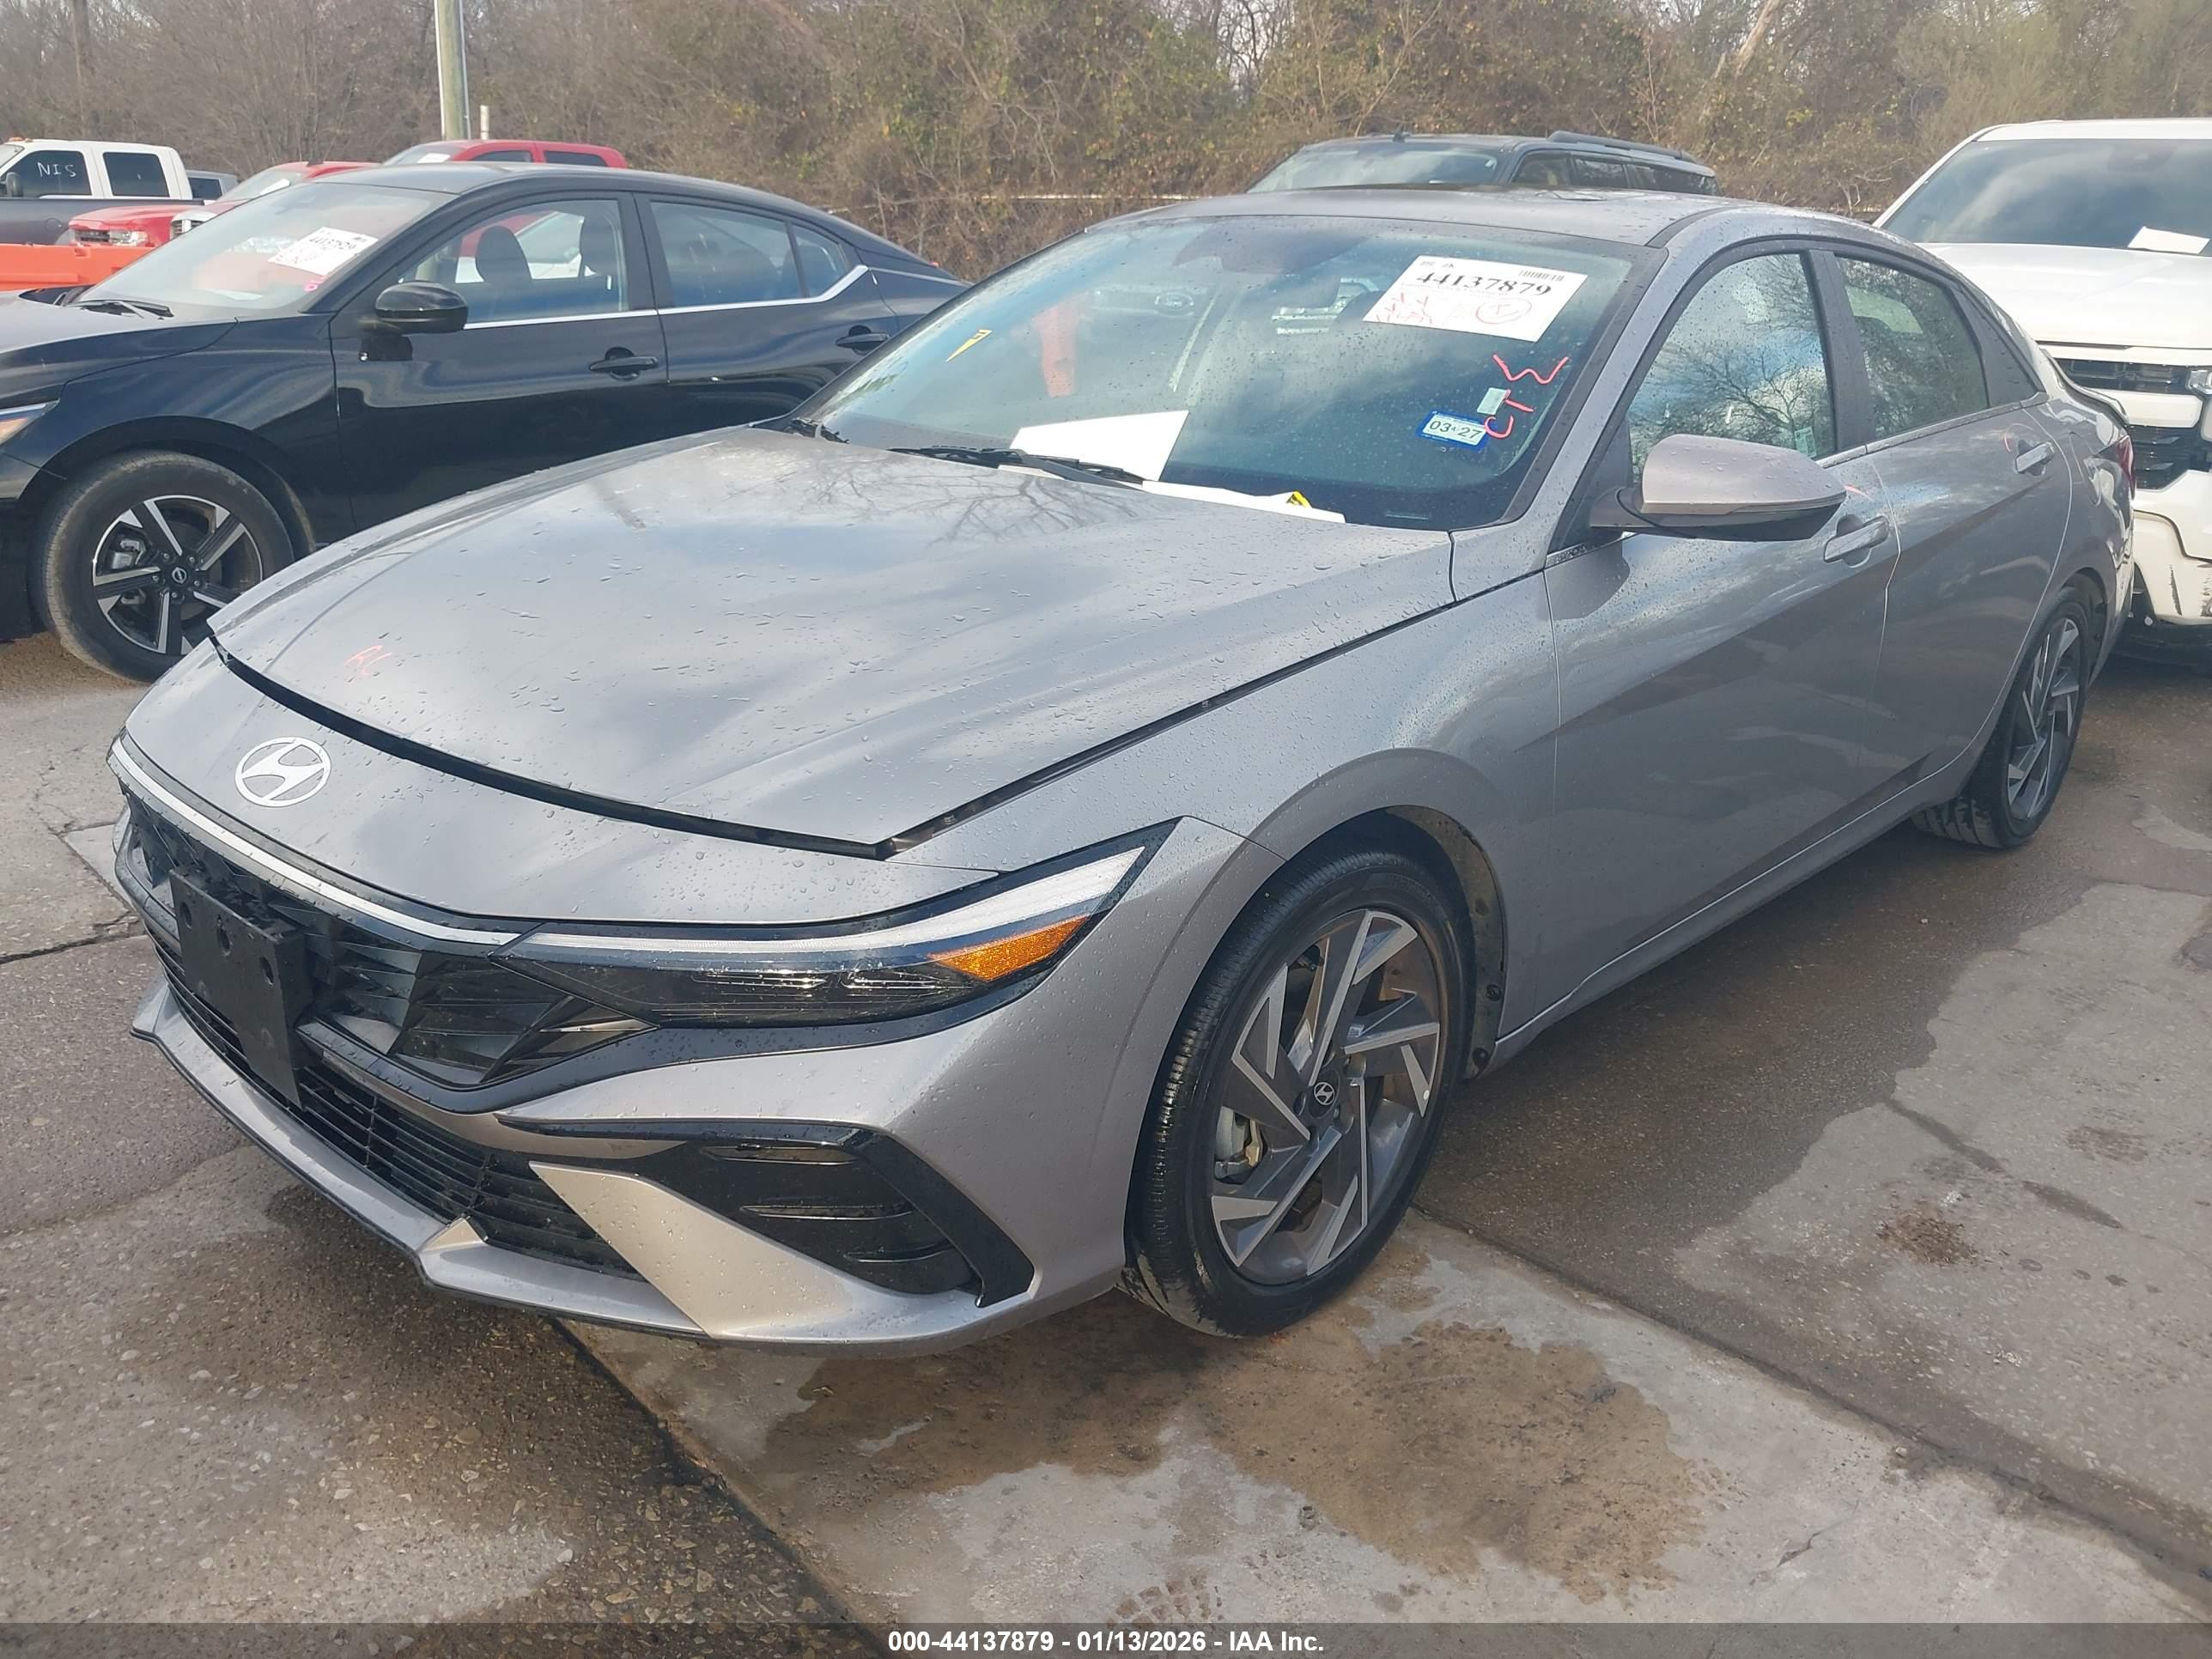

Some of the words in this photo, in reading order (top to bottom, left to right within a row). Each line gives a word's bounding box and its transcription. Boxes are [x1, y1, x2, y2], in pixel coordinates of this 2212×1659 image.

[37, 161, 76, 178] NIS
[1416, 271, 1553, 296] 44137879
[1428, 420, 1452, 434] 03
[1457, 427, 1482, 440] 27
